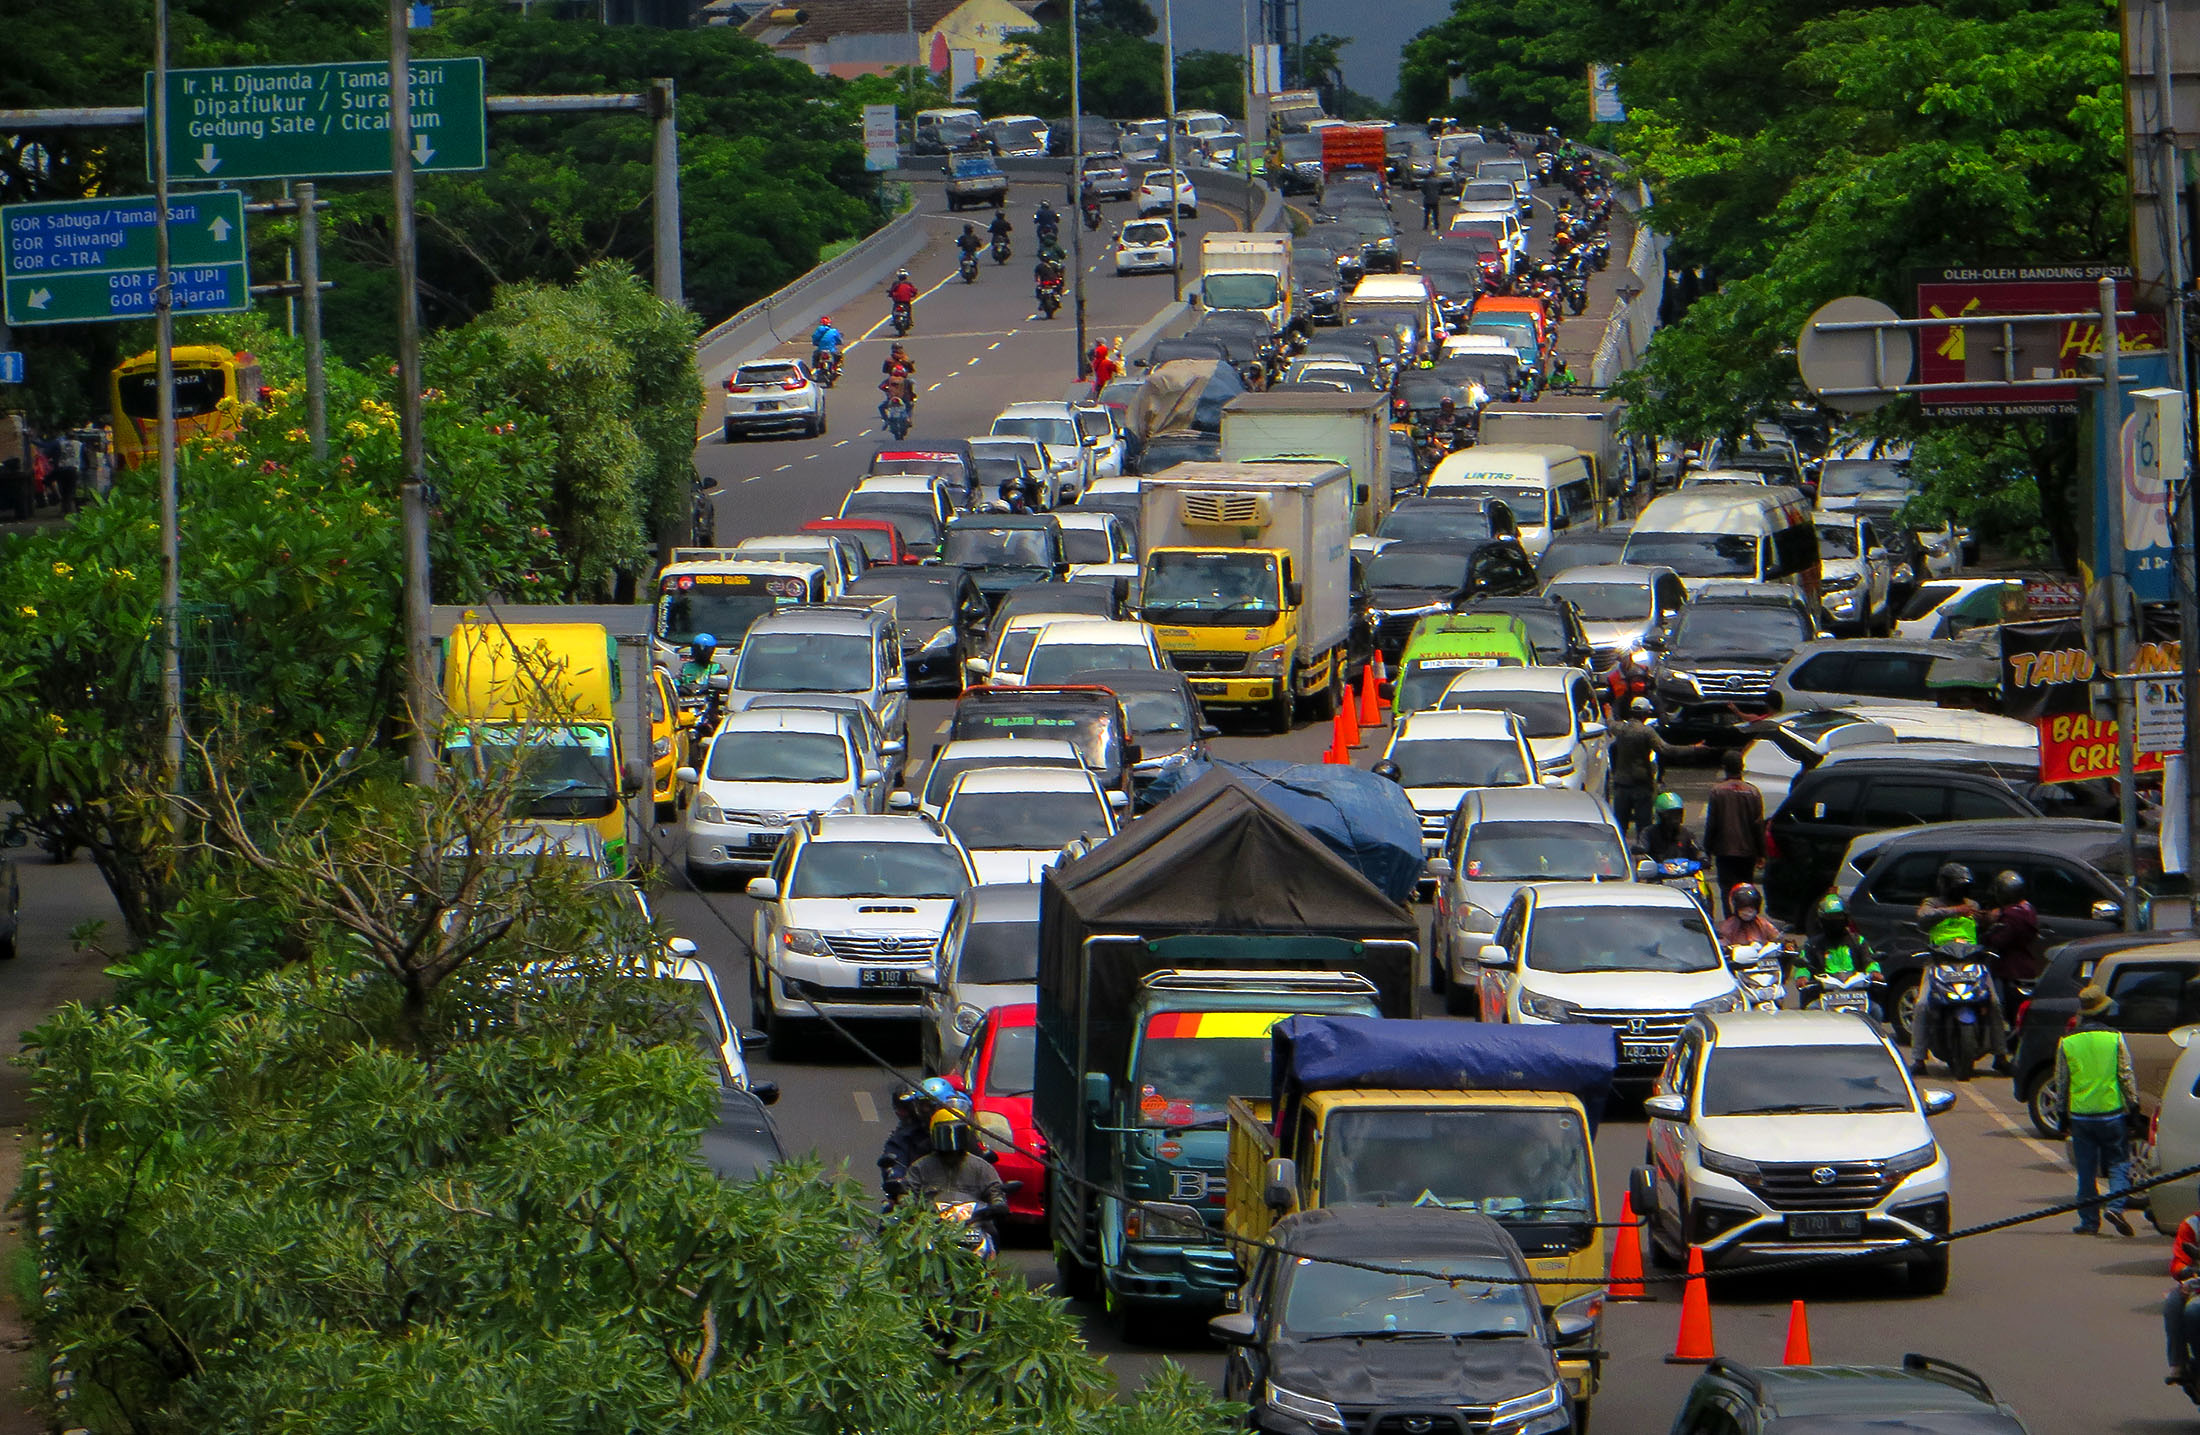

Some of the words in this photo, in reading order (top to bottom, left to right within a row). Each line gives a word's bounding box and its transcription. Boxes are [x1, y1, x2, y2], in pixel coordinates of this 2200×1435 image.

[211, 76, 229, 93] H.
[234, 72, 312, 97] Djuanda
[337, 71, 390, 88] Tama
[409, 66, 443, 84] Sari
[194, 94, 306, 119] Dipatiukur
[341, 88, 434, 109] Suraati
[189, 119, 264, 139] Gedung
[271, 115, 315, 133] Sate
[342, 112, 440, 131] Cicaum
[10, 217, 40, 232] GOR
[166, 206, 195, 221] Sari
[12, 237, 43, 251] GOR
[54, 230, 123, 248] Siliwangi
[13, 256, 43, 270] GOR
[50, 251, 102, 267] C-TRA
[109, 275, 141, 289] GOR
[148, 270, 188, 287] FOK
[194, 269, 220, 283] UPI
[1944, 270, 2016, 280] OLEH-OLEH
[2019, 268, 2083, 279] BANDUNG
[2085, 267, 2133, 278] SPESIA
[110, 293, 143, 307] GOR
[149, 289, 226, 306] Pjajaran
[1937, 406, 1985, 416] PASTEUR
[2004, 405, 2056, 415] BANDUNG
[1463, 472, 1514, 481] LINTAS
[2009, 648, 2095, 688] TAHU
[863, 970, 876, 982] BE
[880, 970, 901, 982] 1107
